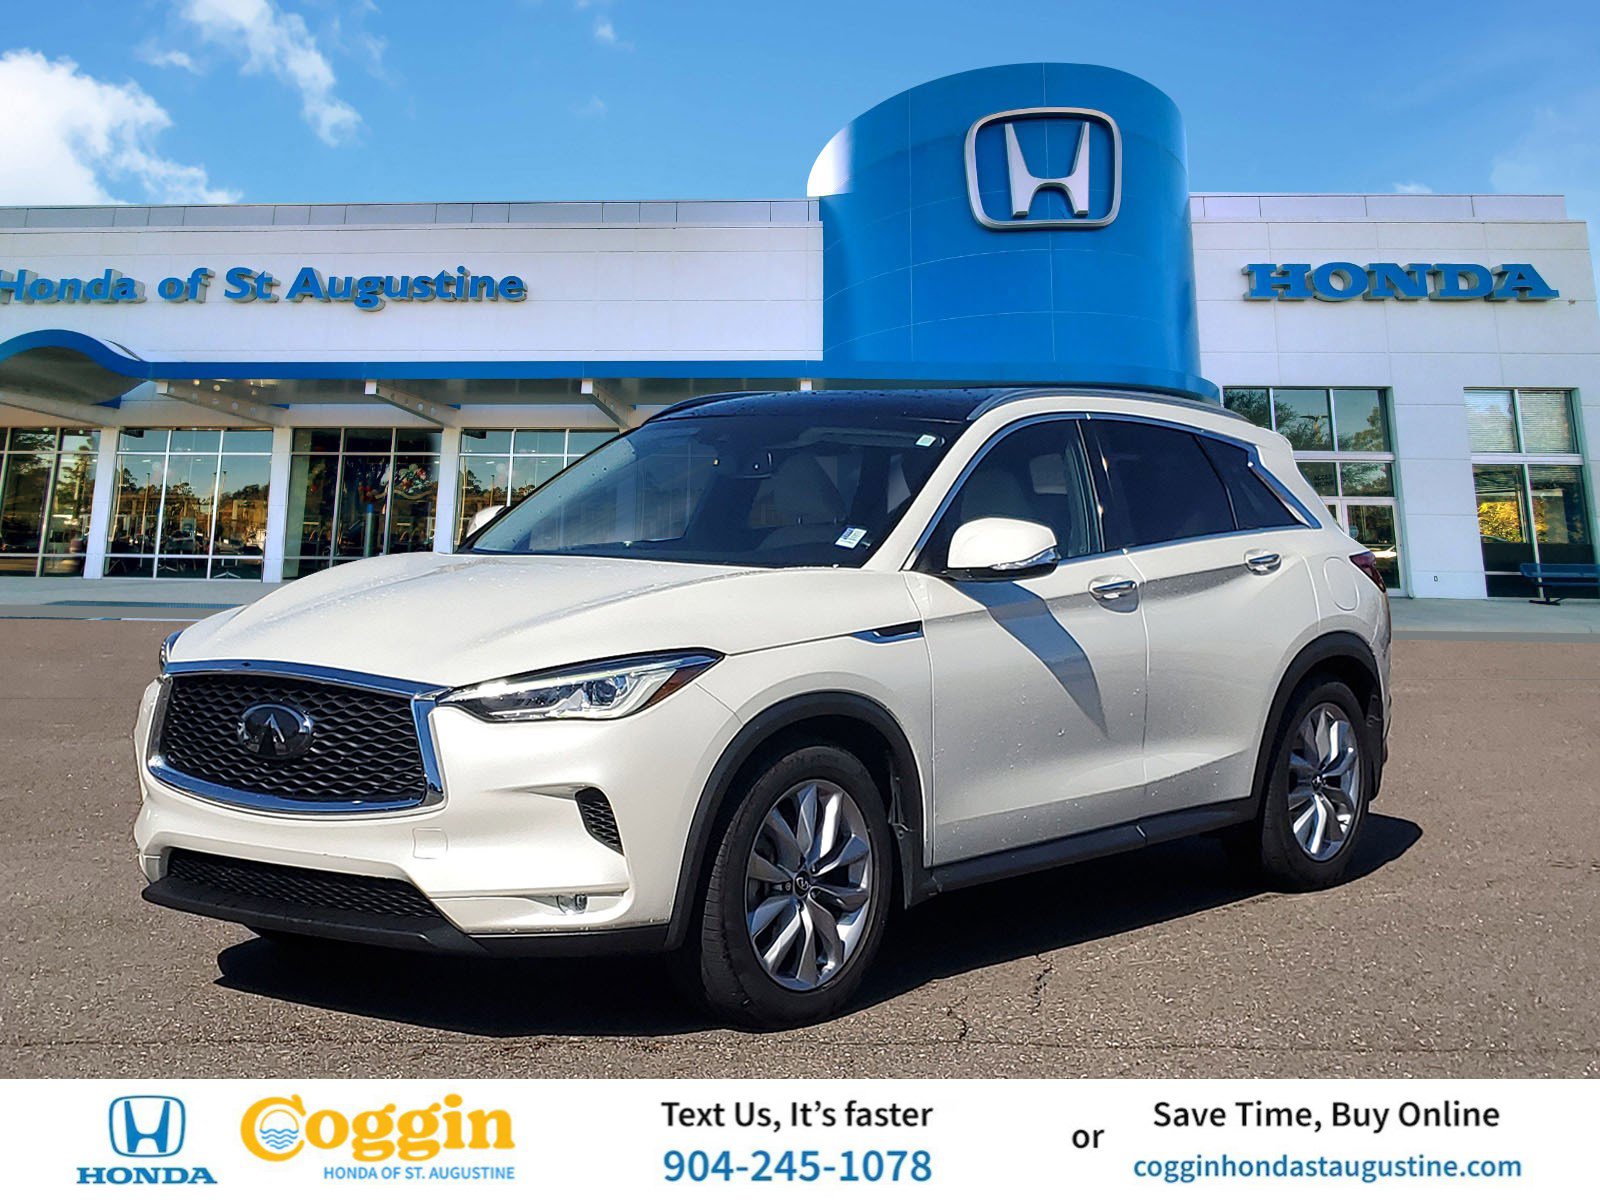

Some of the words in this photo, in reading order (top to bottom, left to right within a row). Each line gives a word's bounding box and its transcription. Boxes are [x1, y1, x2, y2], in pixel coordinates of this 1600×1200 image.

[0, 268, 145, 304] Honda
[158, 267, 214, 303] of
[224, 266, 279, 302] St
[286, 265, 528, 312] Augustine
[1241, 261, 1560, 302] HONDA
